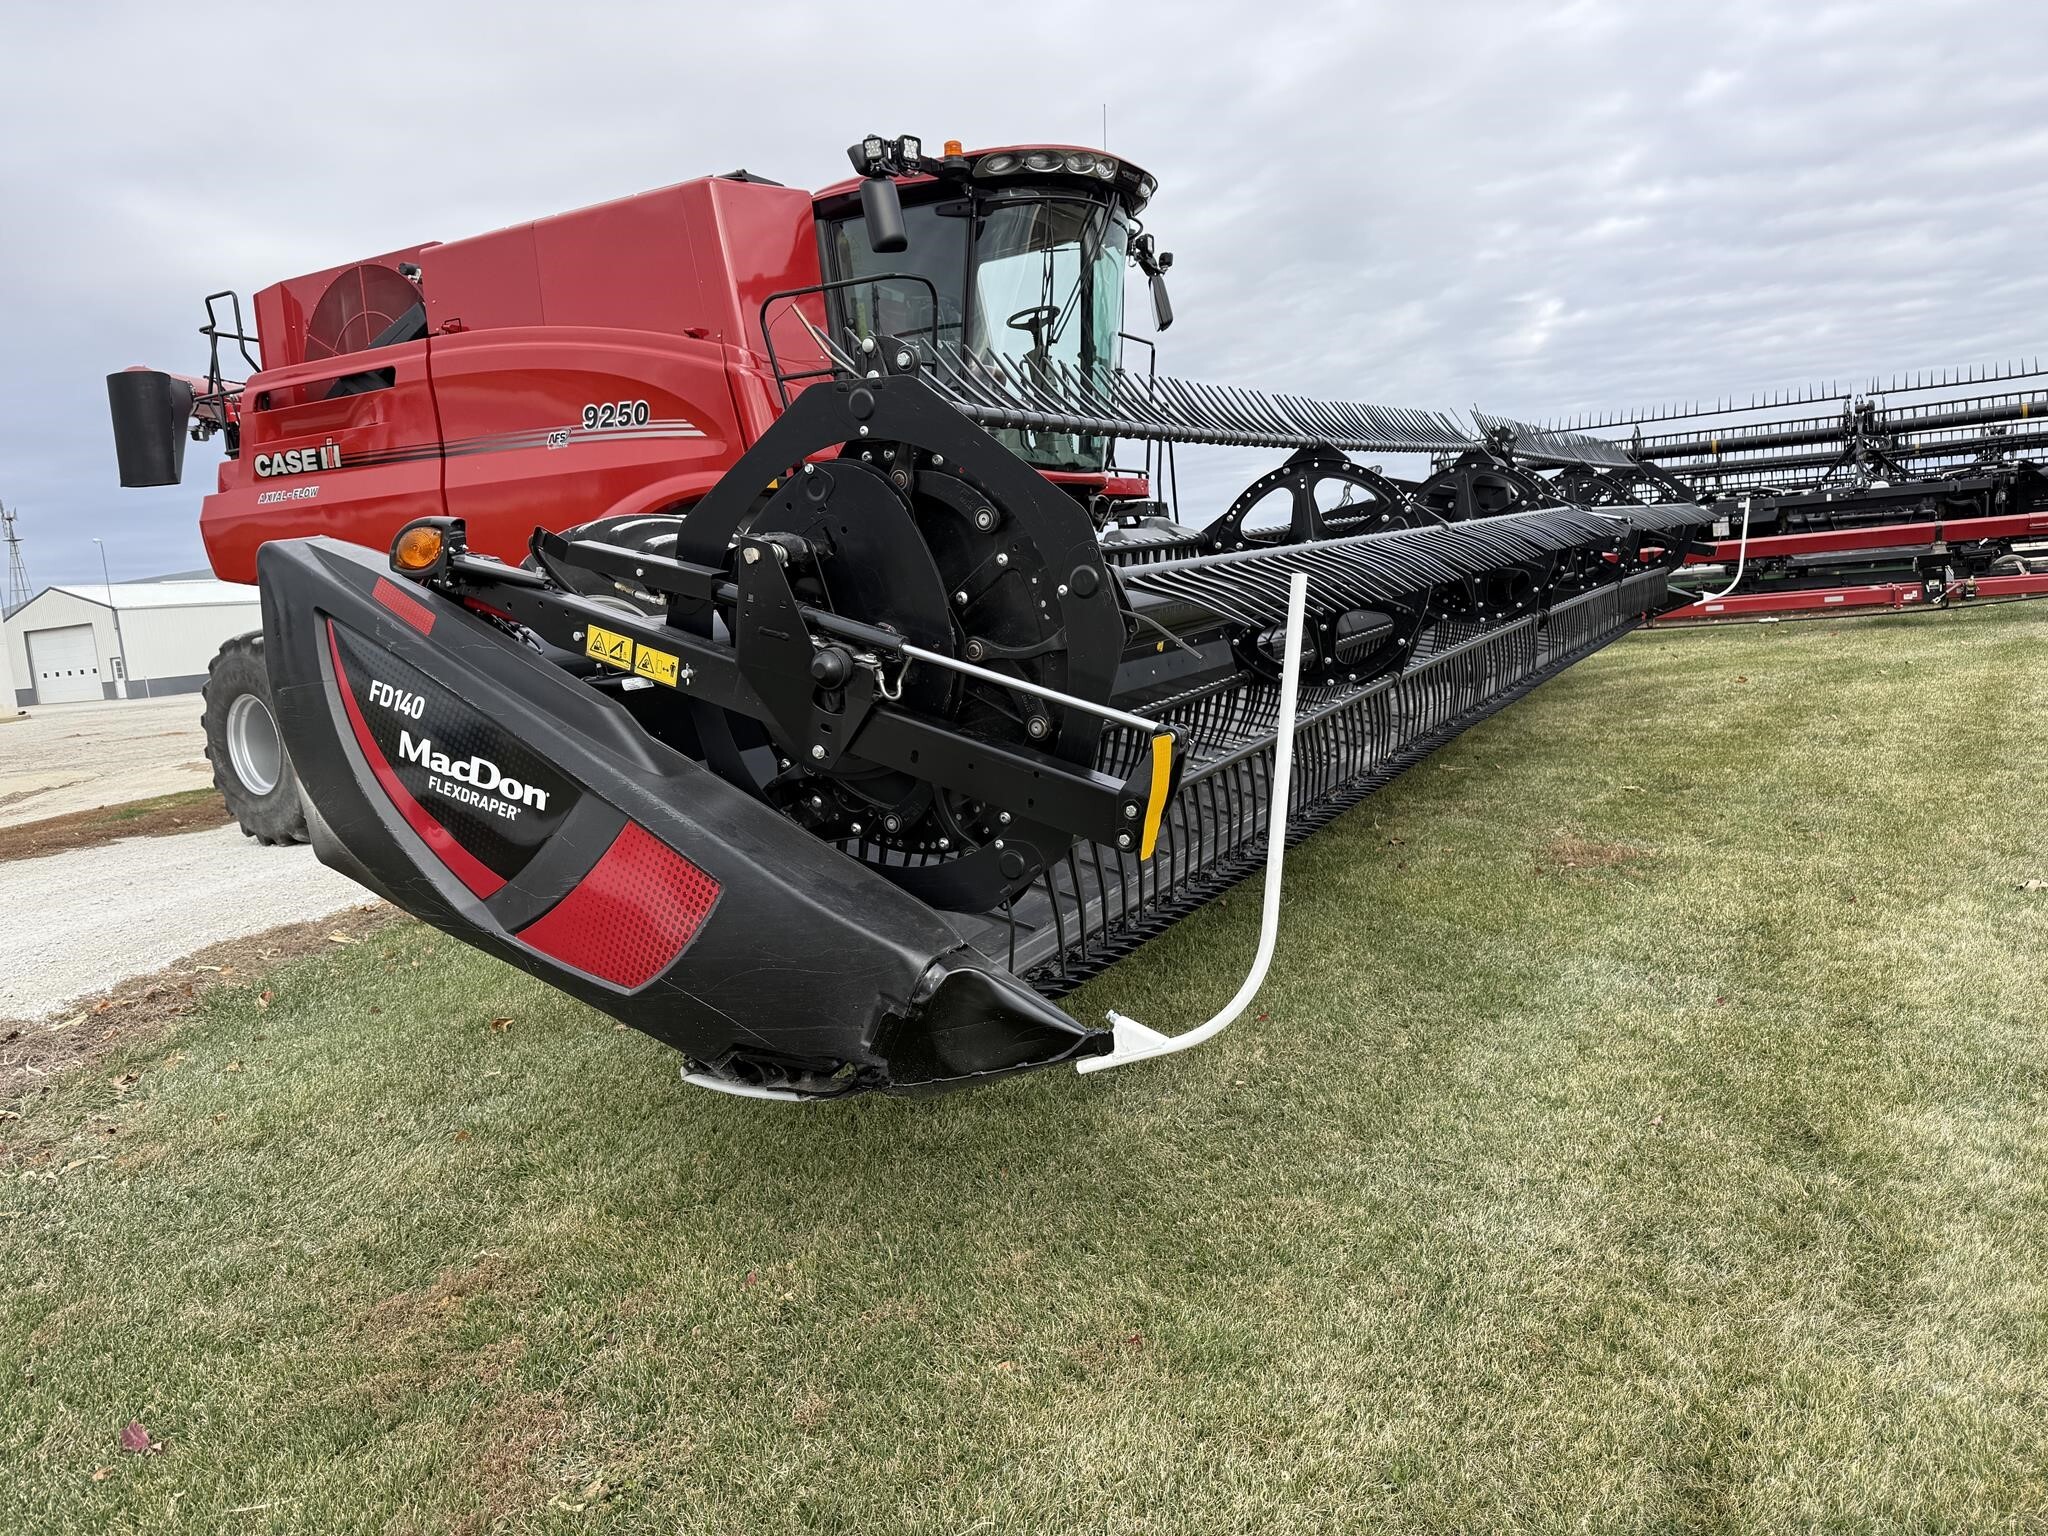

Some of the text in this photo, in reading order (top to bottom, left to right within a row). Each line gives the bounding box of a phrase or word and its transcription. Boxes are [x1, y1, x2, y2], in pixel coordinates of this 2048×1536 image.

[582, 400, 650, 430] 9250
[547, 431, 567, 445] AFS
[254, 447, 319, 477] CASE
[258, 486, 320, 504] AXIAL-FLOW
[368, 679, 426, 720] FD140
[398, 729, 547, 811] MacDon
[428, 775, 519, 821] FLEXDRAPER
